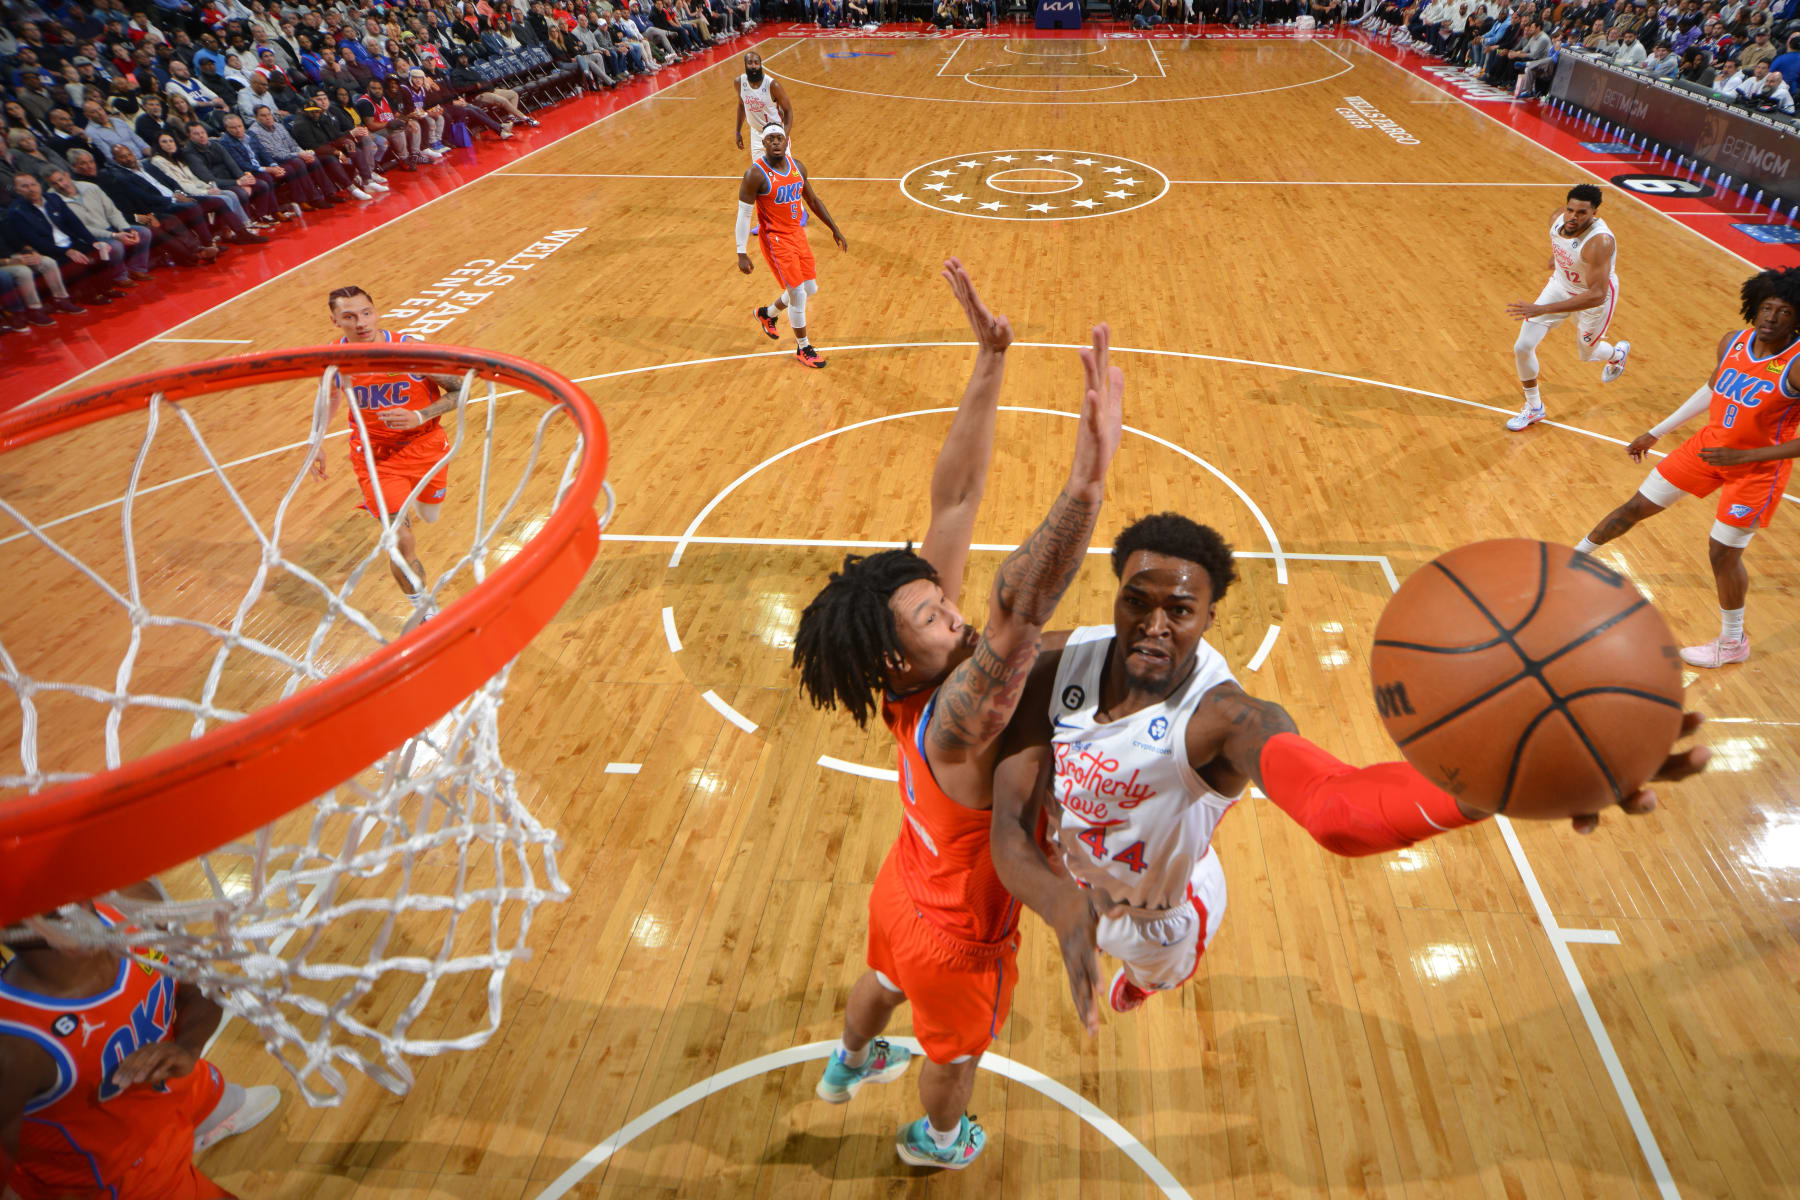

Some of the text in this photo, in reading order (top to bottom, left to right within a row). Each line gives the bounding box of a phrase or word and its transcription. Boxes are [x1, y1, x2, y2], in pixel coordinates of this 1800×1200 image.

[1602, 88, 1649, 120] BETMGM
[1369, 118, 1421, 145] FARGO
[1722, 135, 1792, 178] BETMGM
[774, 181, 803, 204] OKC
[791, 203, 797, 219] 5
[380, 258, 496, 319] CENTER
[397, 226, 588, 342] WELLS FAR
[1564, 269, 1582, 283] 12
[352, 381, 411, 410] OKC
[1714, 367, 1775, 408] OKC
[1722, 403, 1739, 429] 8
[1065, 688, 1082, 708] 6
[1053, 742, 1157, 810] Brotherly
[1056, 778, 1118, 822] Love
[1077, 826, 1149, 875] 44
[55, 1015, 76, 1036] 6
